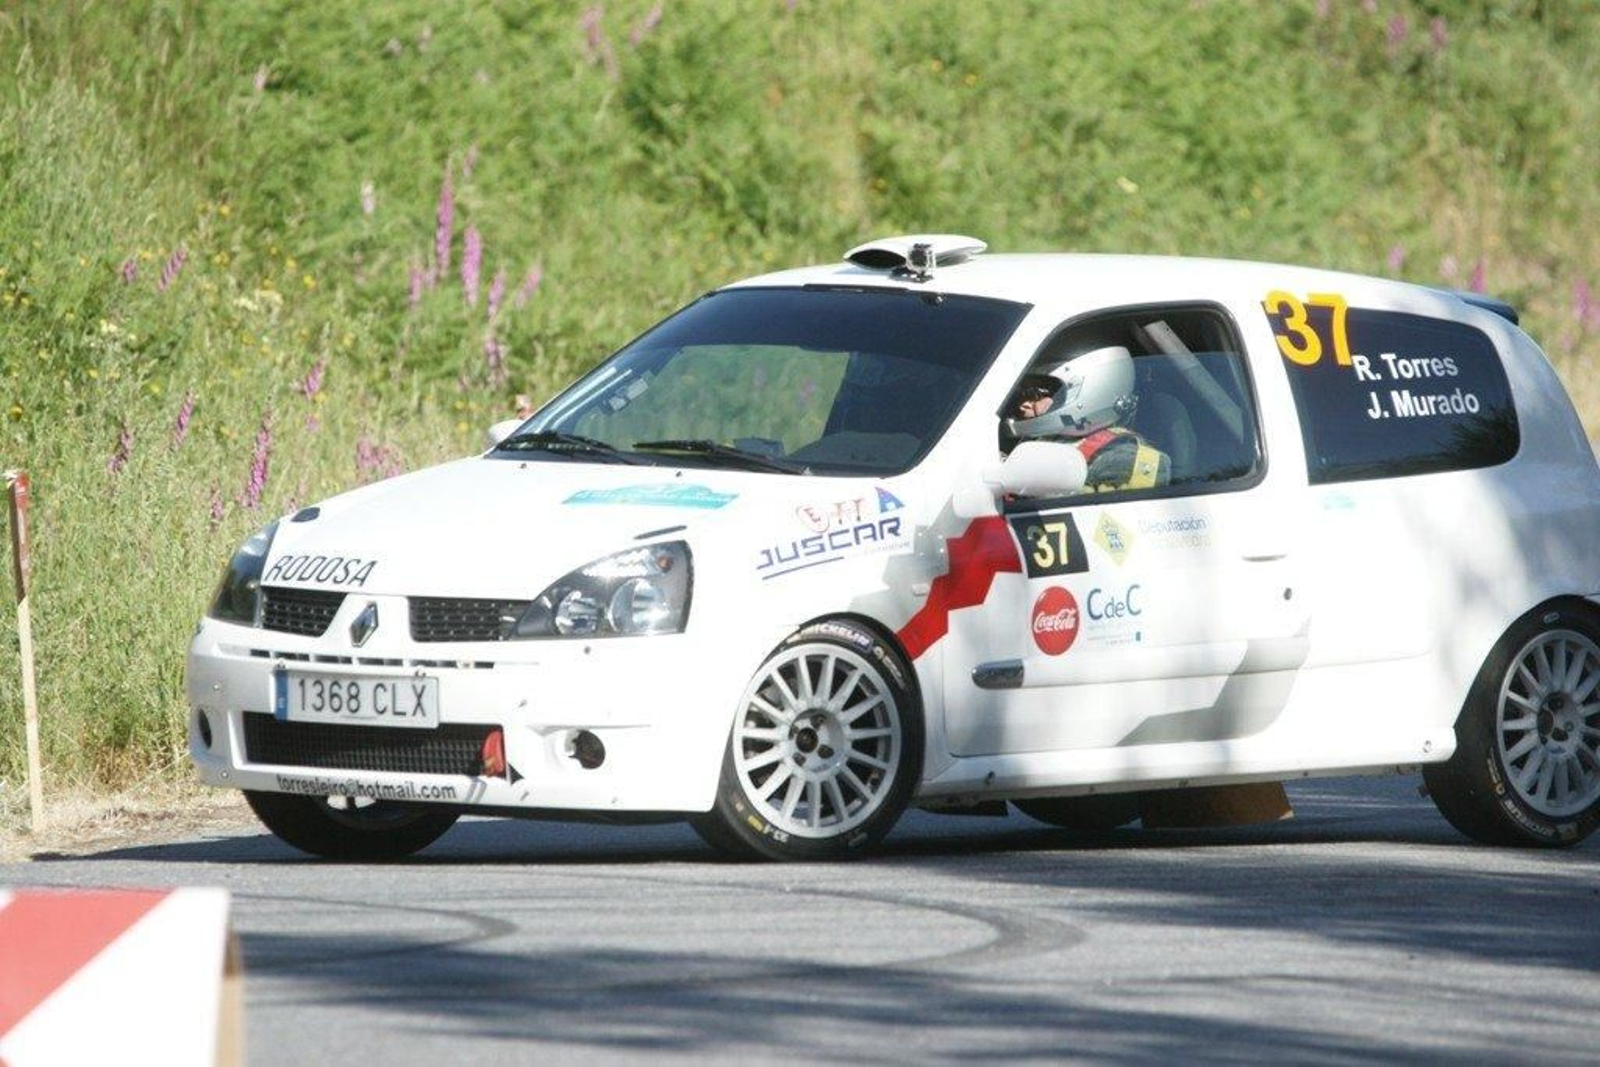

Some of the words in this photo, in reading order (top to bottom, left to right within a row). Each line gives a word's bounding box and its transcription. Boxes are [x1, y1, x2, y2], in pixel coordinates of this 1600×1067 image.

[1264, 290, 1352, 366] 37
[1353, 354, 1382, 381] R.
[1381, 353, 1459, 379] Torres
[1367, 391, 1389, 419] J.
[1390, 388, 1480, 418] Murado
[755, 516, 902, 570] JUSCAR
[1027, 522, 1068, 568] 37
[264, 554, 379, 588] RODOSA
[298, 678, 361, 714] 1368
[373, 683, 426, 718] CLX
